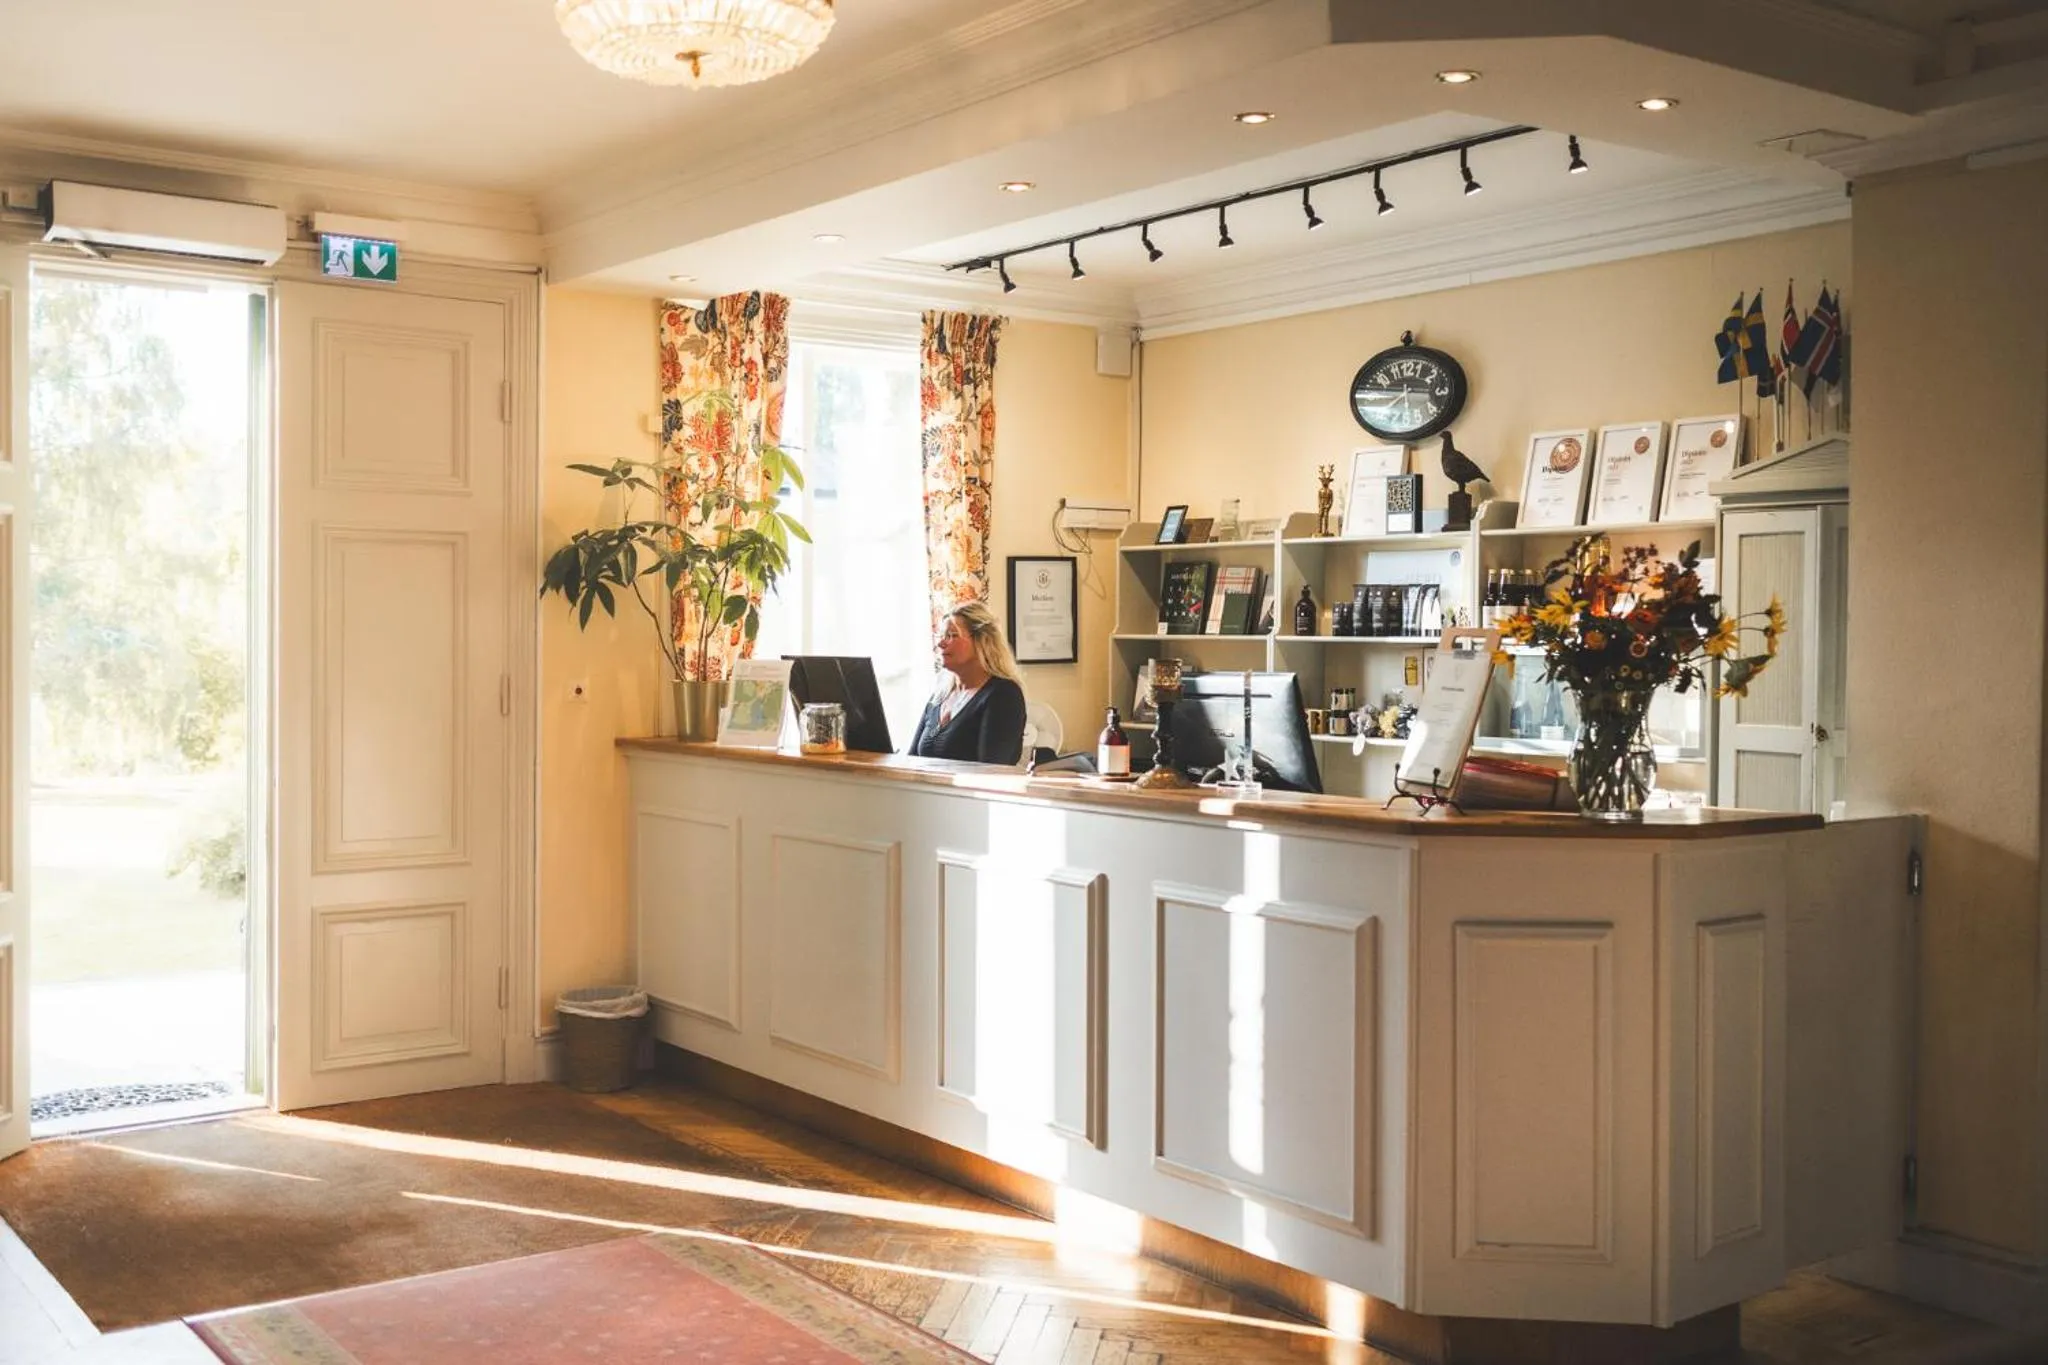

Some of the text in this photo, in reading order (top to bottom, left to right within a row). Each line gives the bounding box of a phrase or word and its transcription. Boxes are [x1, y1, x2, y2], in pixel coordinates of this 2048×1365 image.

[1390, 362, 1400, 380] 11
[1401, 361, 1414, 377] 12
[1416, 363, 1422, 378] 1
[1377, 374, 1390, 388] 10
[1425, 369, 1438, 385] 2
[1435, 387, 1449, 396] 3
[1427, 402, 1437, 415] 4
